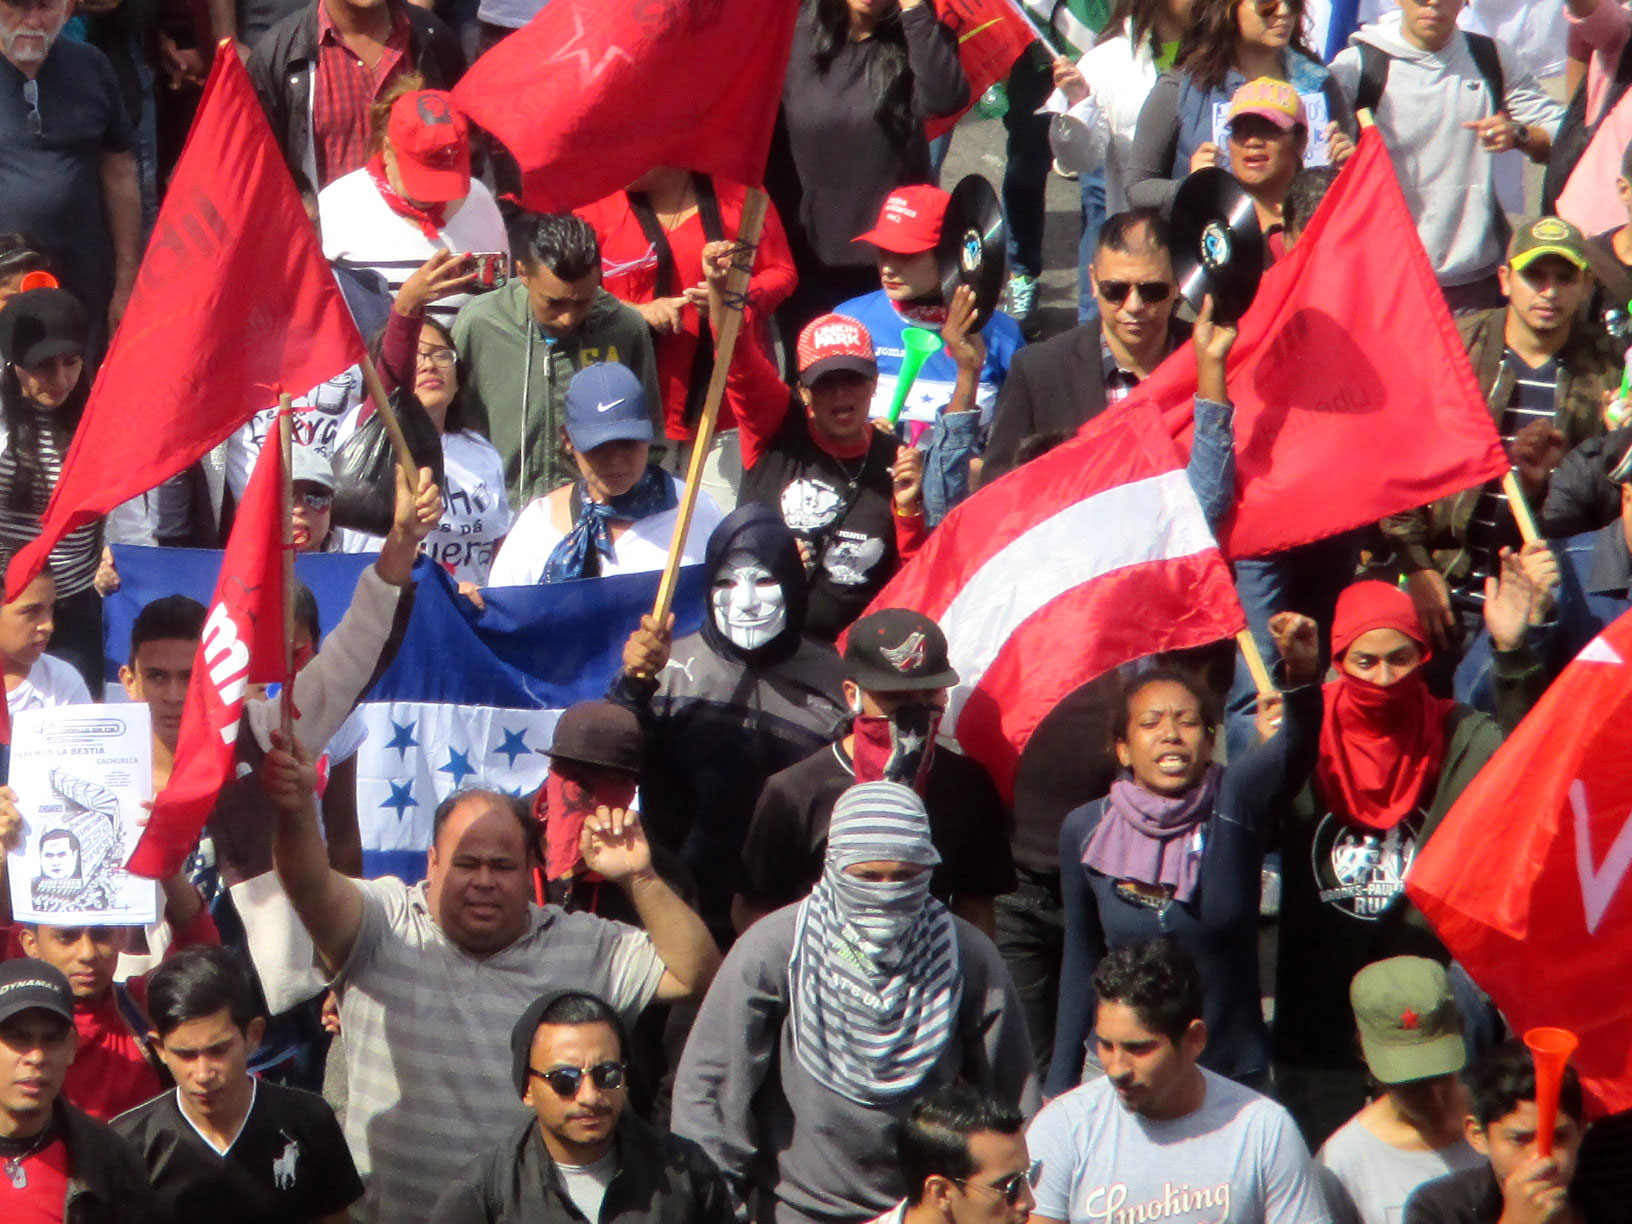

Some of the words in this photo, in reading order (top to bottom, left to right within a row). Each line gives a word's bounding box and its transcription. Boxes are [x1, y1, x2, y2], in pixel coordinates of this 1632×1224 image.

[814, 323, 859, 337] LINKIN
[814, 333, 861, 349] PARK
[70, 747, 106, 755] BESTIA
[1085, 1182, 1231, 1224] Smoking
